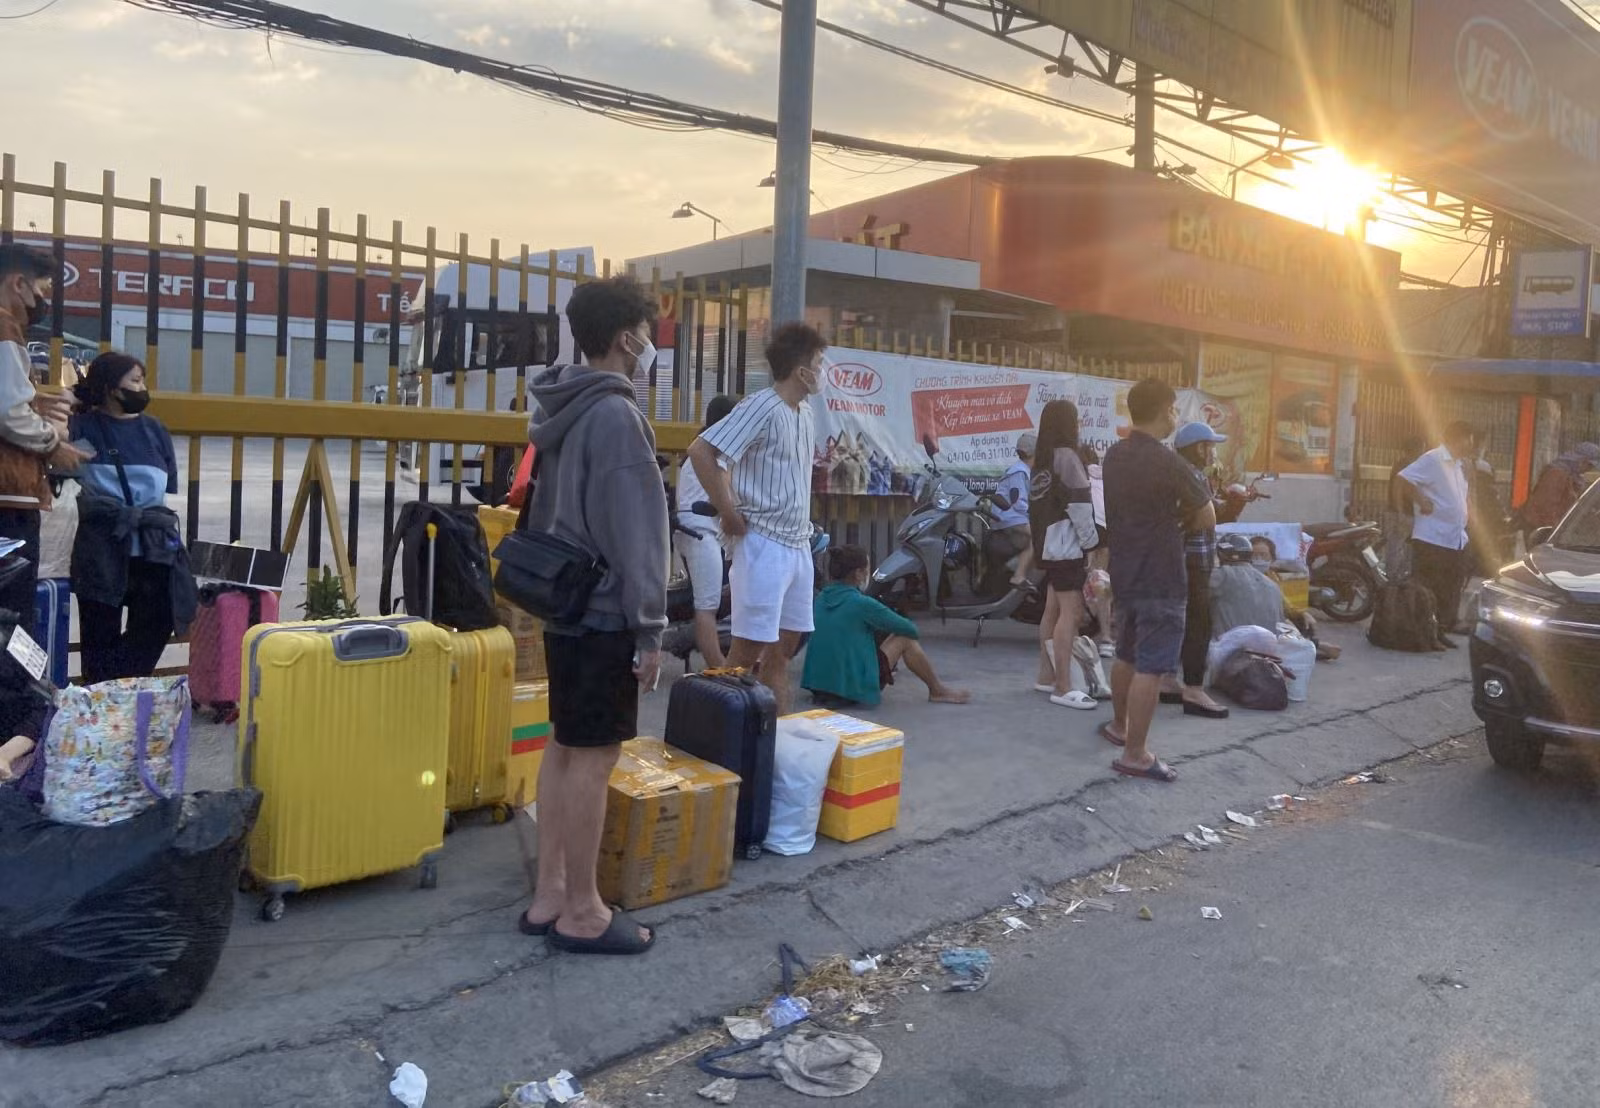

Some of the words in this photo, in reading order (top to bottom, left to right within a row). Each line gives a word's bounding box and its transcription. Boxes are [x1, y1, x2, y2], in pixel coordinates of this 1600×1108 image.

[1464, 37, 1532, 120] VEAM
[377, 290, 411, 313] Tế
[833, 367, 875, 391] VEAM
[826, 398, 854, 414] VEAM
[854, 401, 886, 417] MOTOR
[1002, 408, 1022, 420] VEAM
